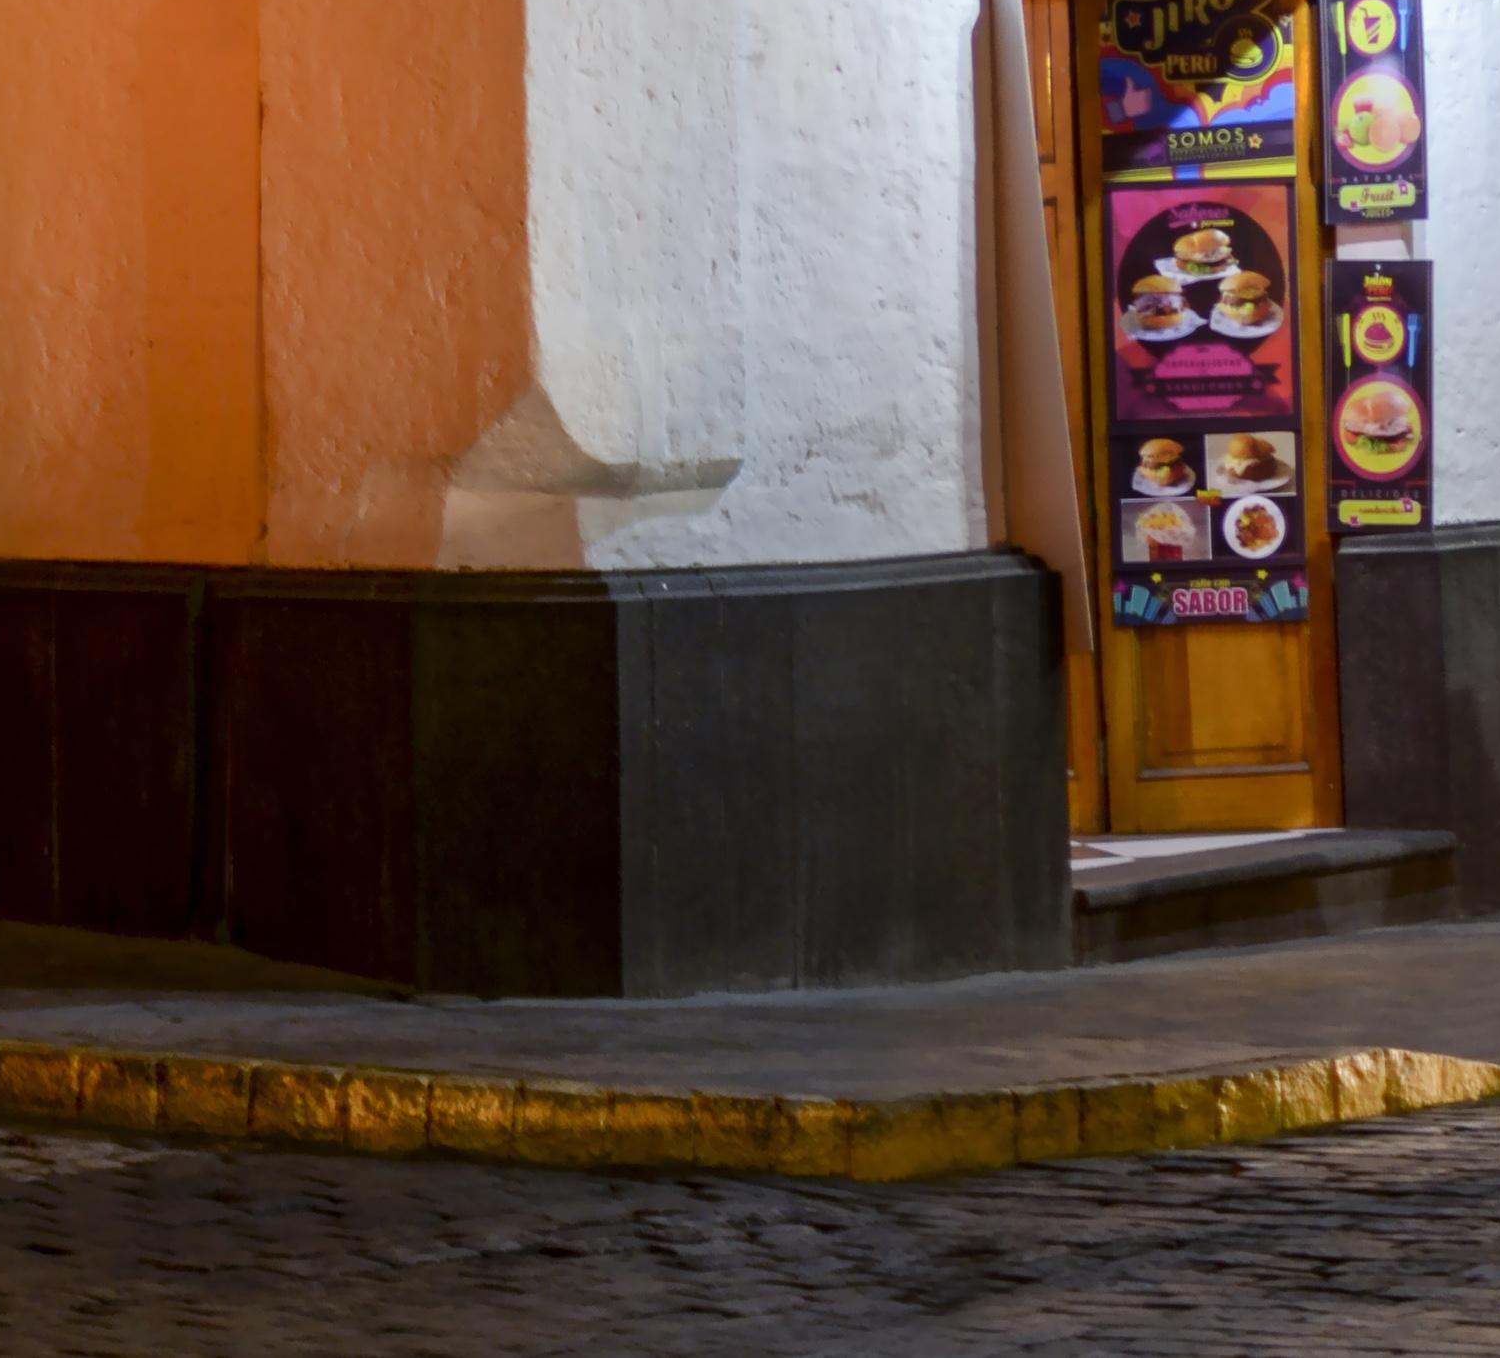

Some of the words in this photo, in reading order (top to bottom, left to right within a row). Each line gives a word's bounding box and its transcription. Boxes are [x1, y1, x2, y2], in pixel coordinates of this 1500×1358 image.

[1167, 126, 1245, 150] SOMOS
[1361, 187, 1394, 203] Fruit
[1173, 586, 1249, 615] SABOR
